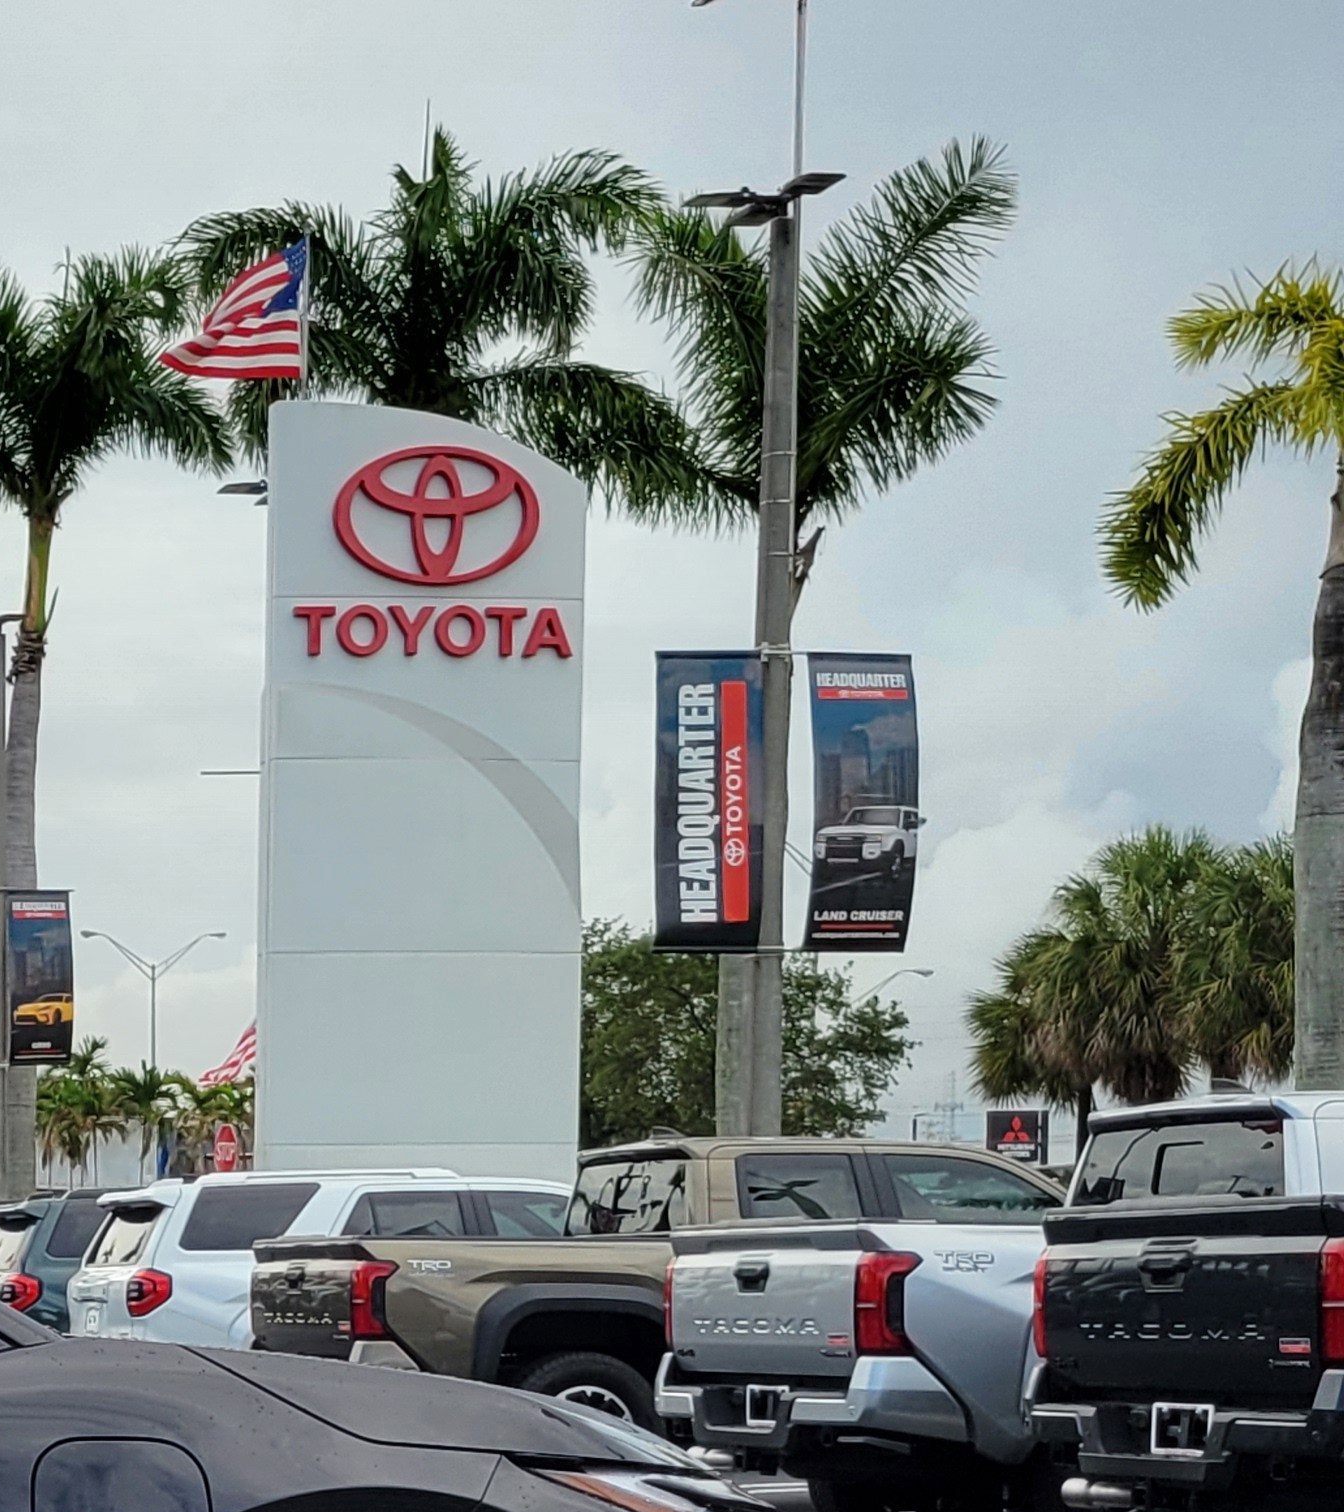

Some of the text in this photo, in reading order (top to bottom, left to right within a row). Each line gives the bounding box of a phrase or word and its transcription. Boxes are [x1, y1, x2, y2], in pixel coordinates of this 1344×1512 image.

[293, 604, 573, 658] TOYOTA
[816, 672, 908, 689] HEADQUARTER
[725, 745, 744, 836] TOYOTA
[677, 683, 719, 923] HEADQUARTER
[813, 909, 904, 921] LAND CRUISER
[693, 1317, 820, 1335] TACOMA
[1079, 1323, 1266, 1341] TACOMA
